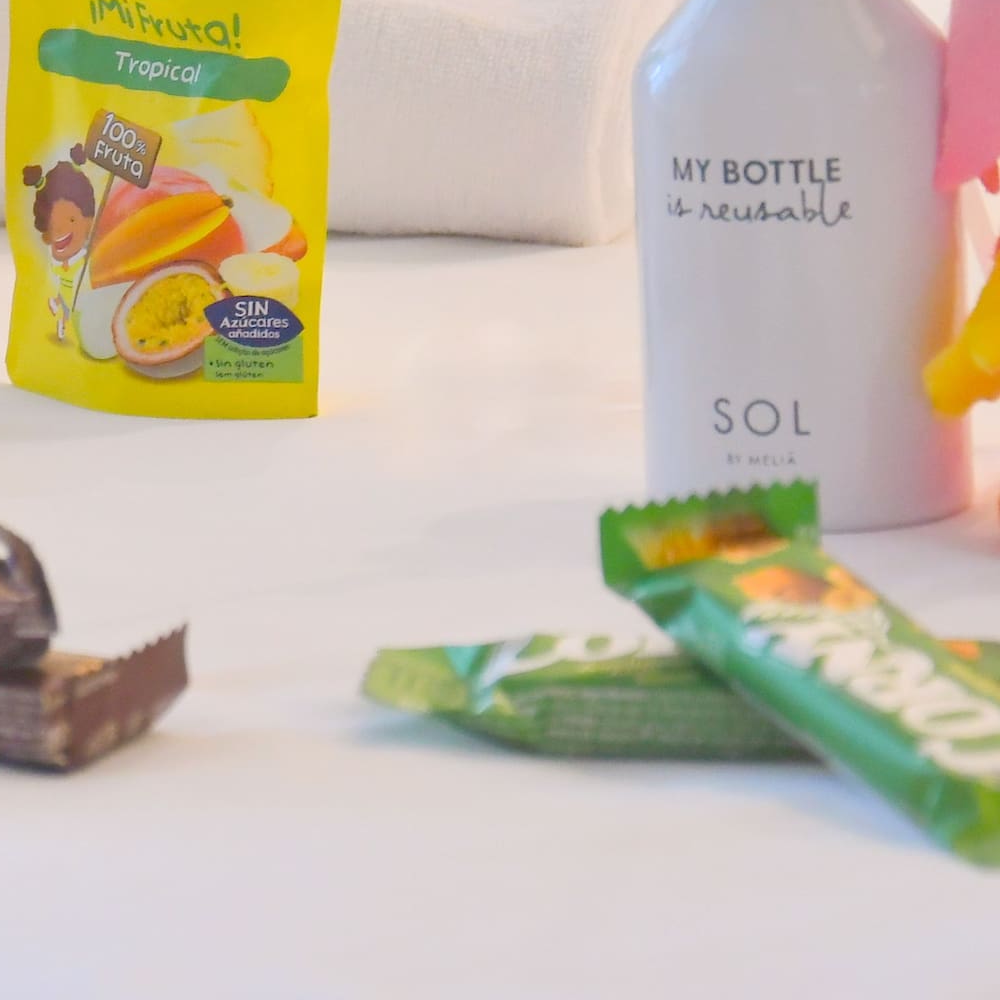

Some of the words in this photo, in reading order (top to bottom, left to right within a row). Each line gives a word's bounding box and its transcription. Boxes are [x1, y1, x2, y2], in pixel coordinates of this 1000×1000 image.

[136, 2, 242, 49] Fruta!
[114, 50, 201, 84] Tropical
[101, 112, 147, 155] 100%
[672, 157, 711, 183] MY
[723, 157, 841, 186] BOTTLE
[667, 193, 693, 218] is
[700, 181, 853, 227] reusable
[220, 316, 289, 329] Azúcares
[234, 300, 269, 317] SIN
[228, 328, 281, 339] añadidos
[714, 397, 811, 437] SOL
[727, 453, 742, 465] BY
